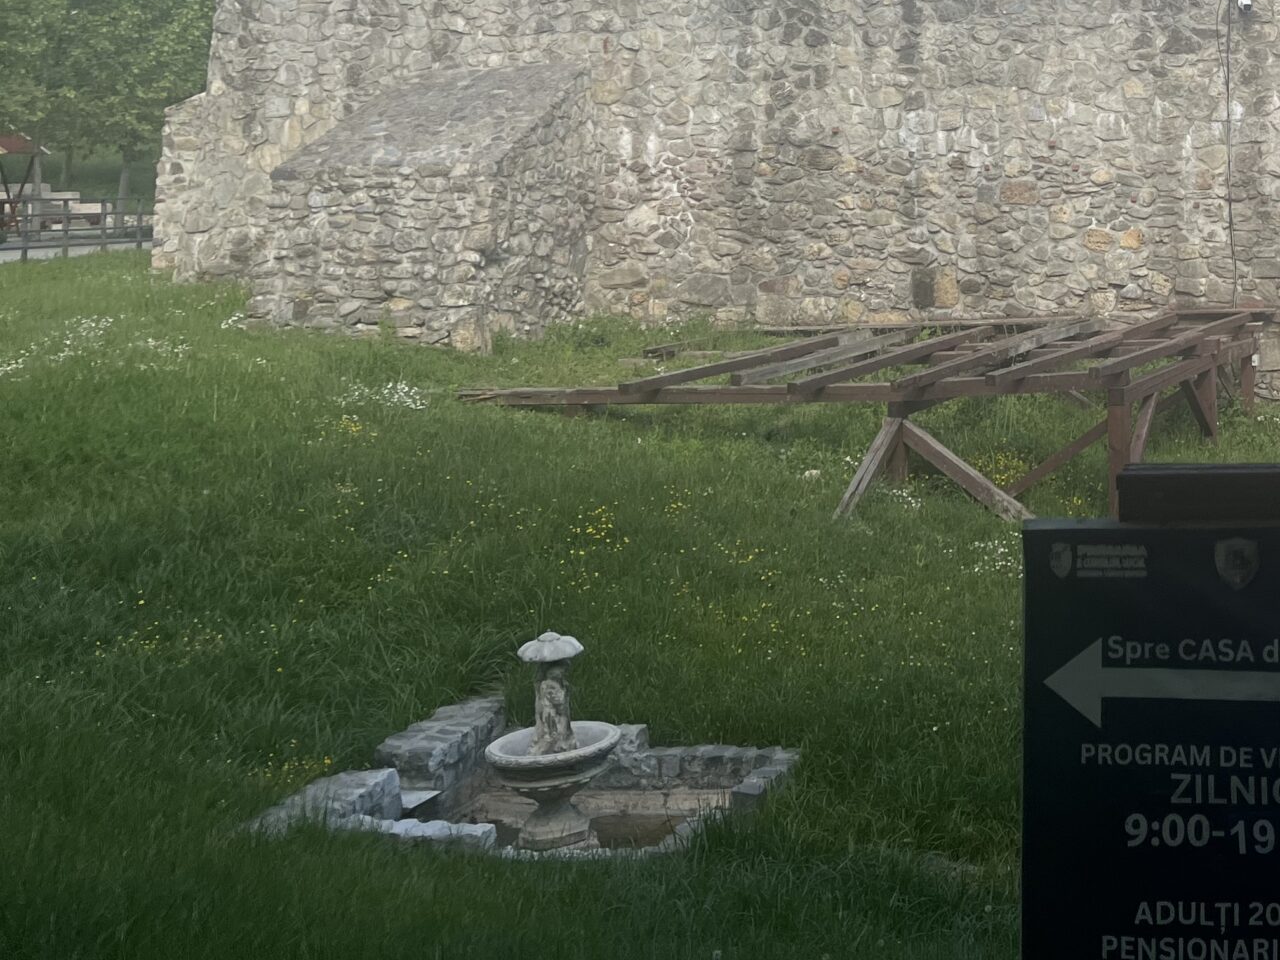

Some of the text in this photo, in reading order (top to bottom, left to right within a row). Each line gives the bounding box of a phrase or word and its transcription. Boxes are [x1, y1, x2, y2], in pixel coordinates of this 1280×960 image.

[1107, 635, 1170, 665] Spre
[1178, 638, 1255, 663] CASA
[1080, 743, 1211, 767] PROGRAM
[1219, 745, 1254, 768] DE
[1101, 935, 1279, 960] PENSIONARI
